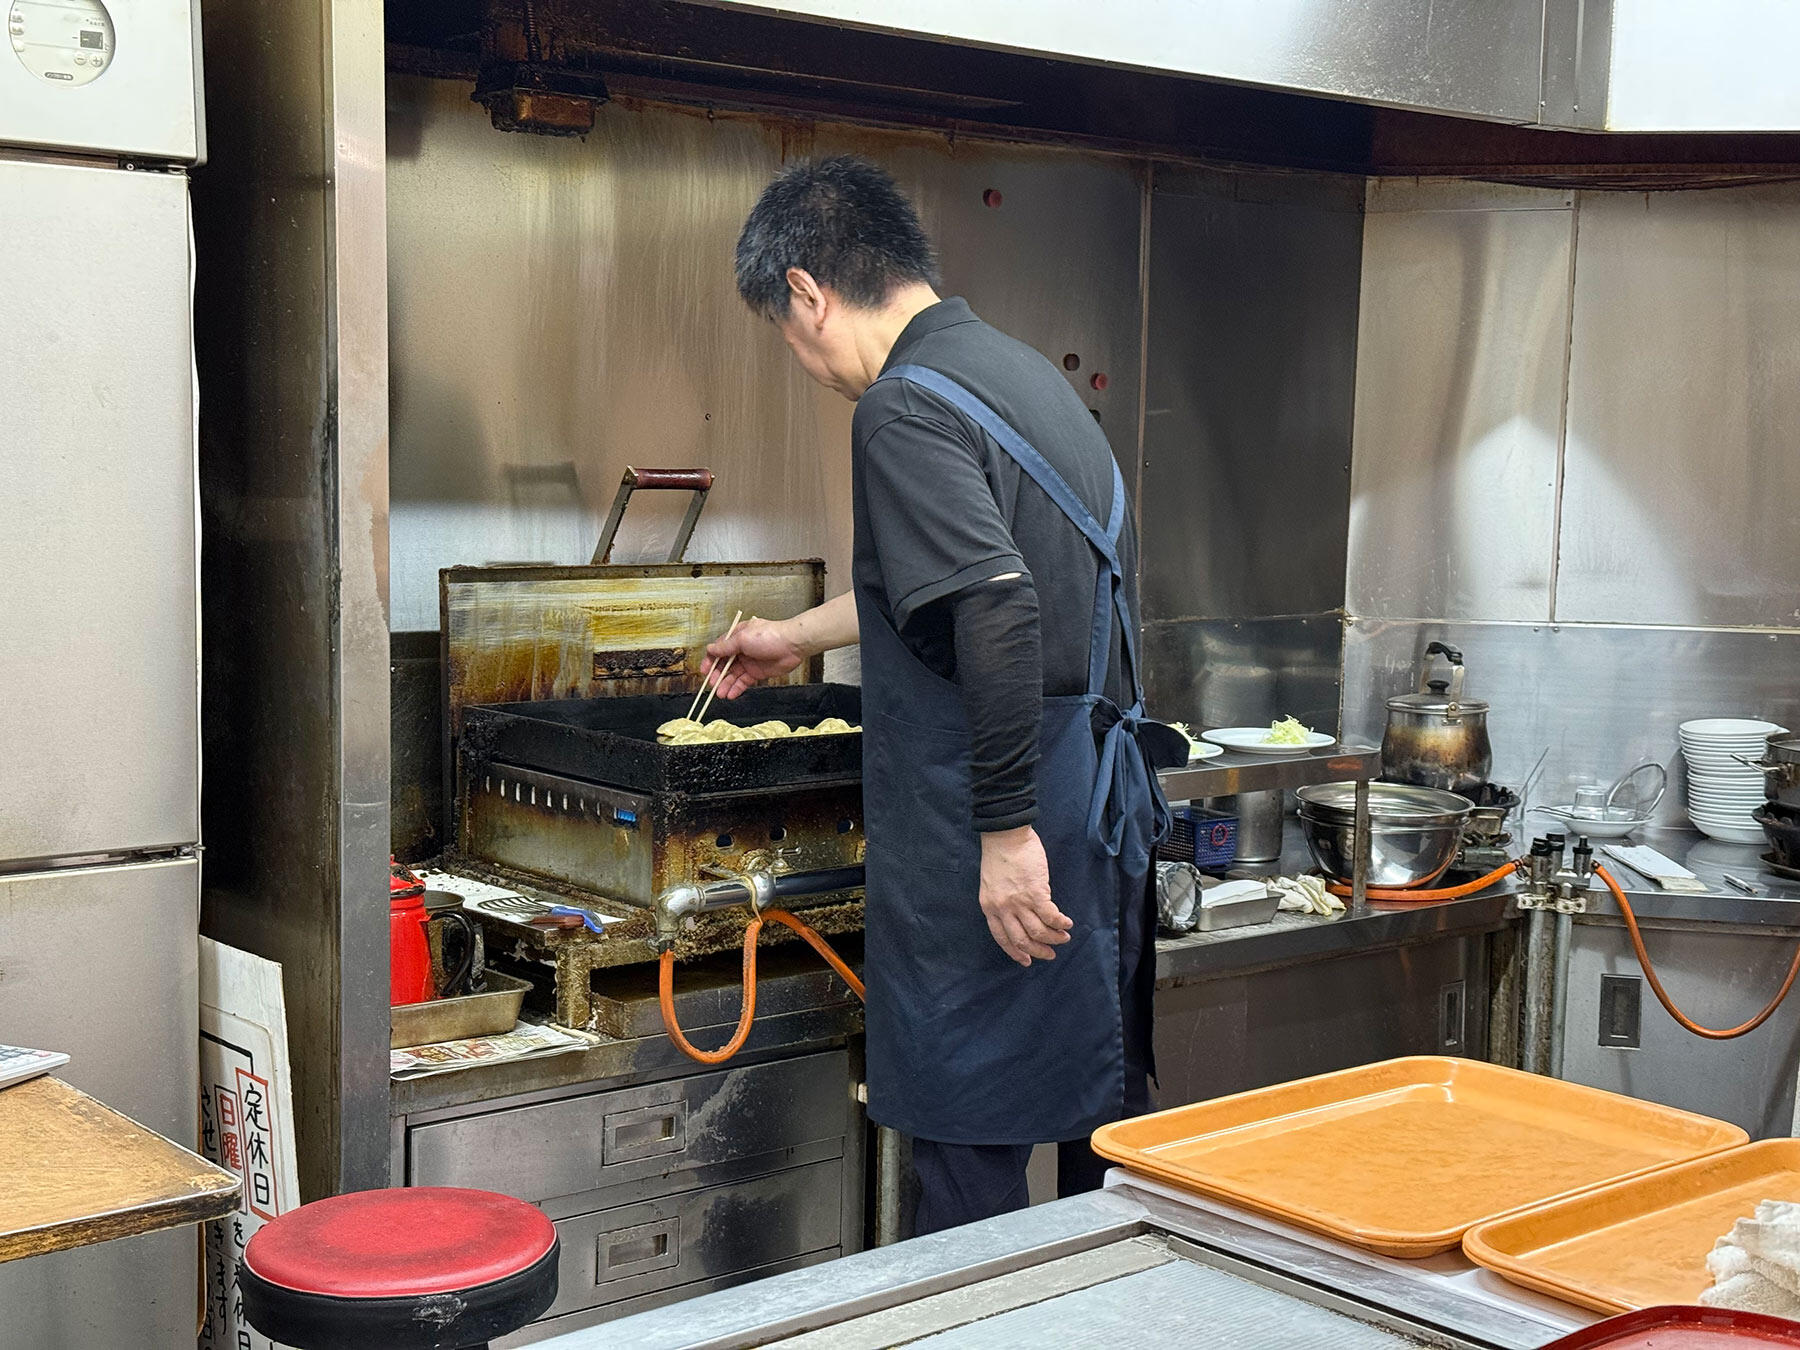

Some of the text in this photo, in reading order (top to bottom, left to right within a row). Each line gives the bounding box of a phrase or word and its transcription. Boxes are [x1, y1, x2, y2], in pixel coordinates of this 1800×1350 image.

[219, 1093, 242, 1171] 日曜
[245, 1083, 270, 1205] 定休日
